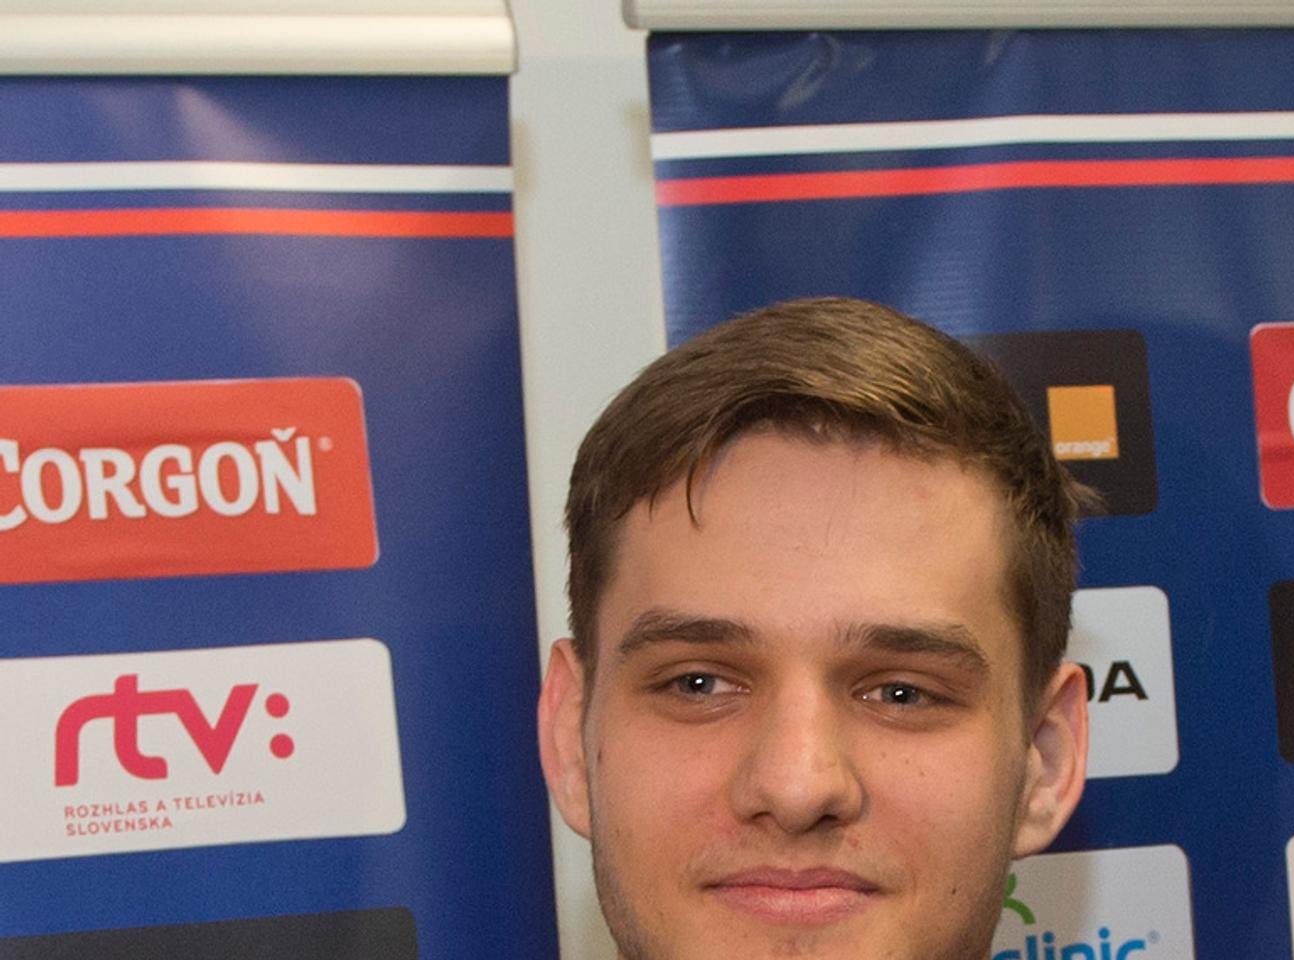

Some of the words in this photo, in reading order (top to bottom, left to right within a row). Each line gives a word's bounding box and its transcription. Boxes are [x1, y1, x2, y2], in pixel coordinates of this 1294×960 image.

[64, 799, 149, 819] ROZHLAS
[156, 799, 167, 813] A
[173, 790, 266, 811] TELEVÍZIA
[65, 815, 174, 837] SLOVENSKA
